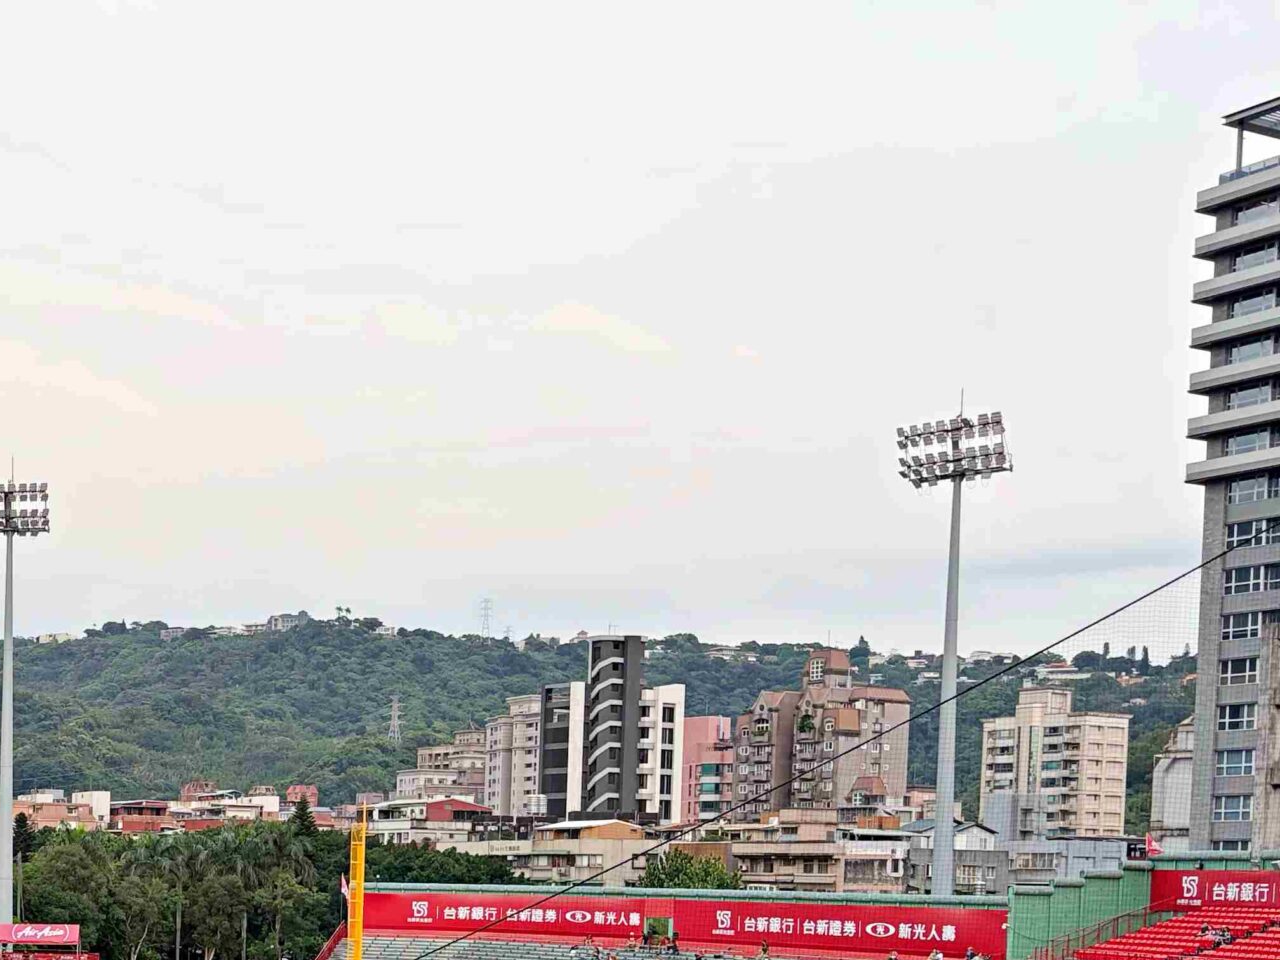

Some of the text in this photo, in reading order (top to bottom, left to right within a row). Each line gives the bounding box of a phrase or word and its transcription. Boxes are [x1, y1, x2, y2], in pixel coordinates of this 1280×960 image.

[1212, 882, 1270, 902] 台新銀行
[443, 906, 498, 921] 台新銀行
[506, 907, 557, 923] 台新證券
[593, 910, 640, 926] 新光人壽
[743, 917, 794, 934] 台新銀行
[803, 919, 857, 937] 台新證券
[898, 923, 956, 942] 新光人壽
